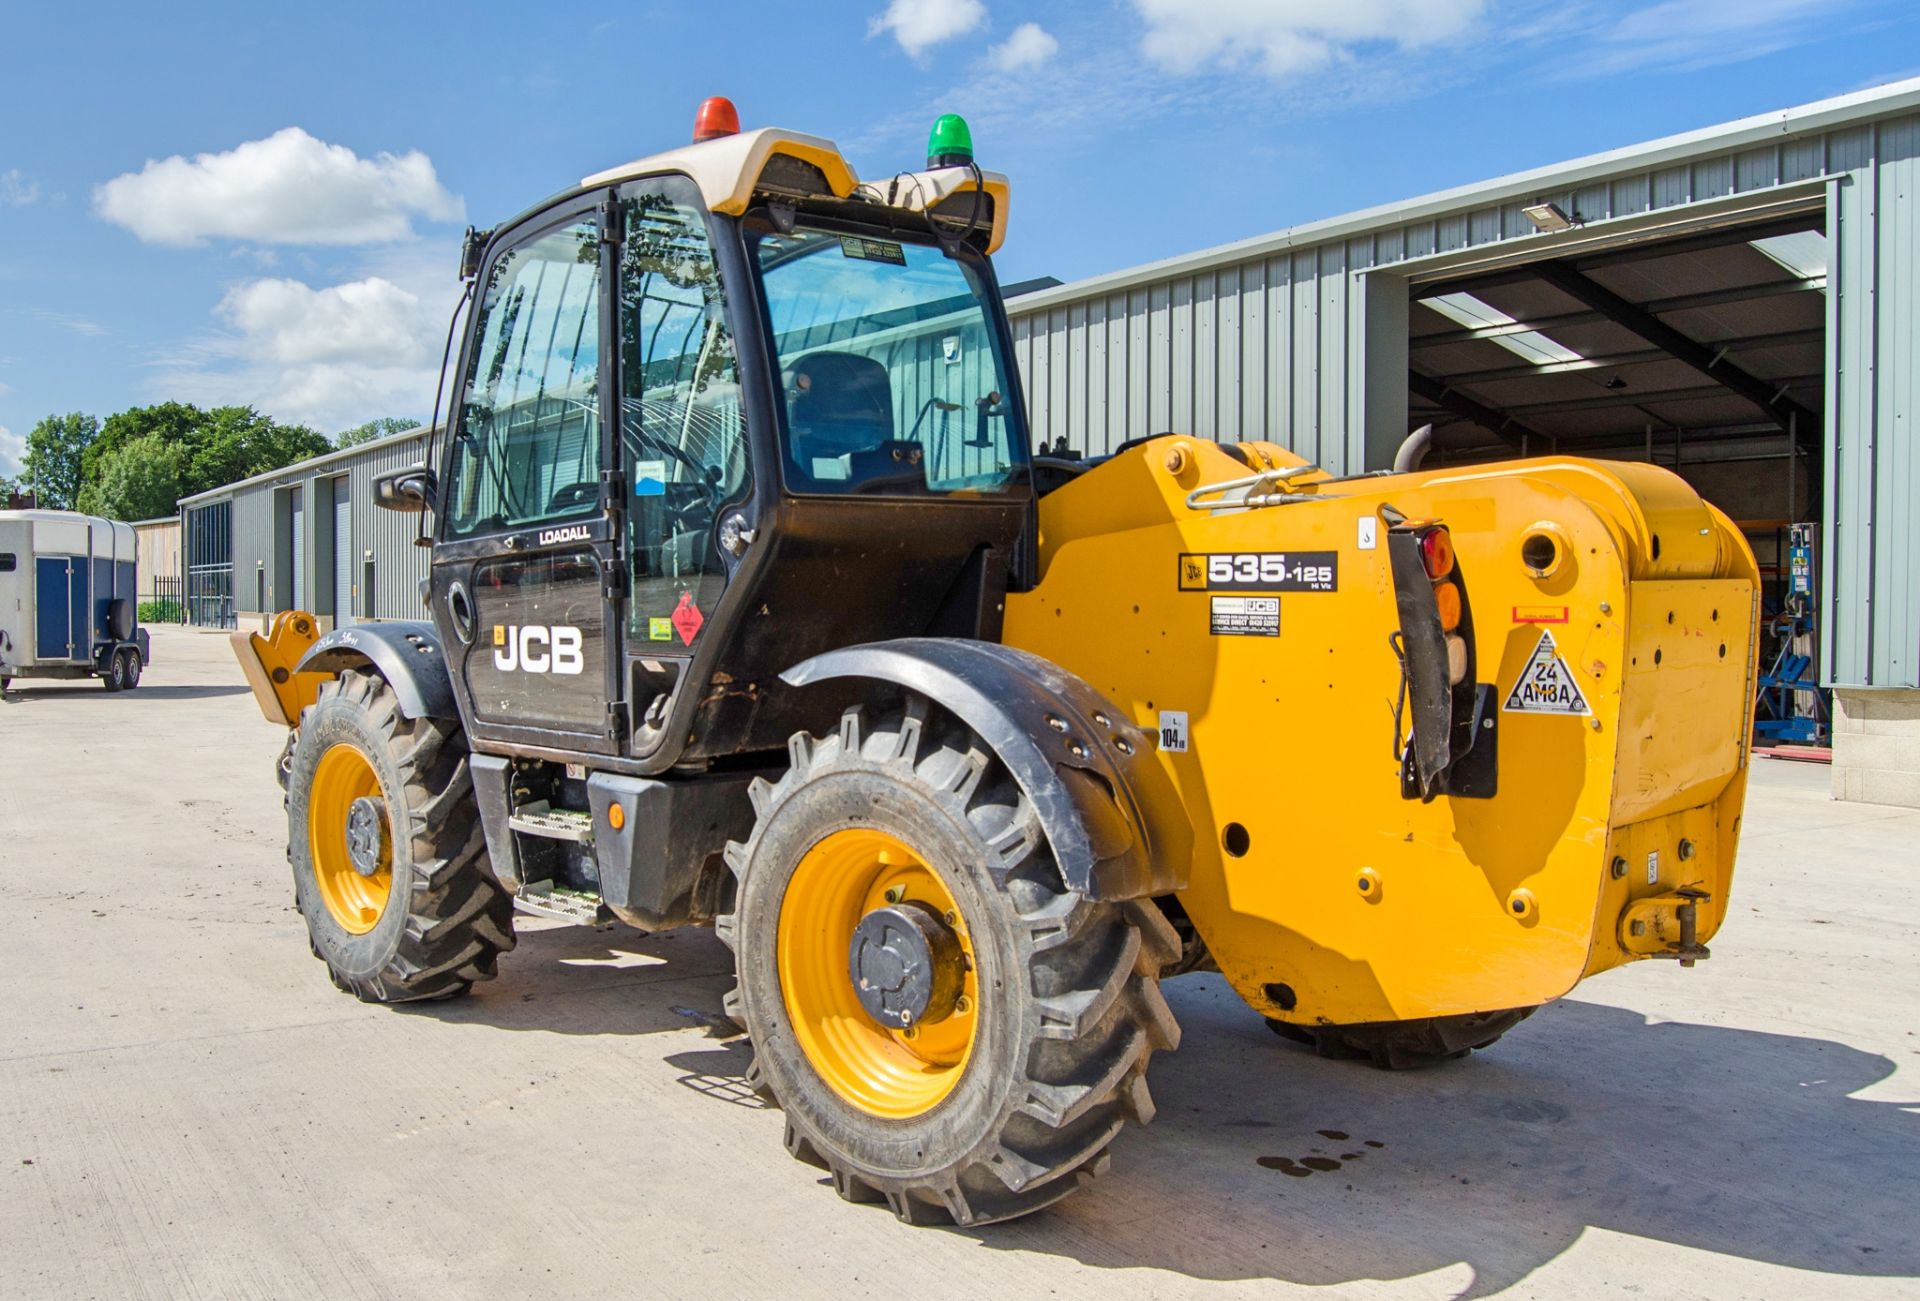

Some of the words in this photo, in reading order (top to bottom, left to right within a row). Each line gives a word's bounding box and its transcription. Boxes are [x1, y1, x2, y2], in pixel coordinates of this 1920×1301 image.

[539, 526, 591, 545] LOADALL
[1247, 601, 1277, 612] JCB
[494, 625, 584, 675] JCB
[1536, 662, 1557, 681] 24
[1523, 683, 1570, 704] AM8A
[1161, 728, 1178, 748] 104
